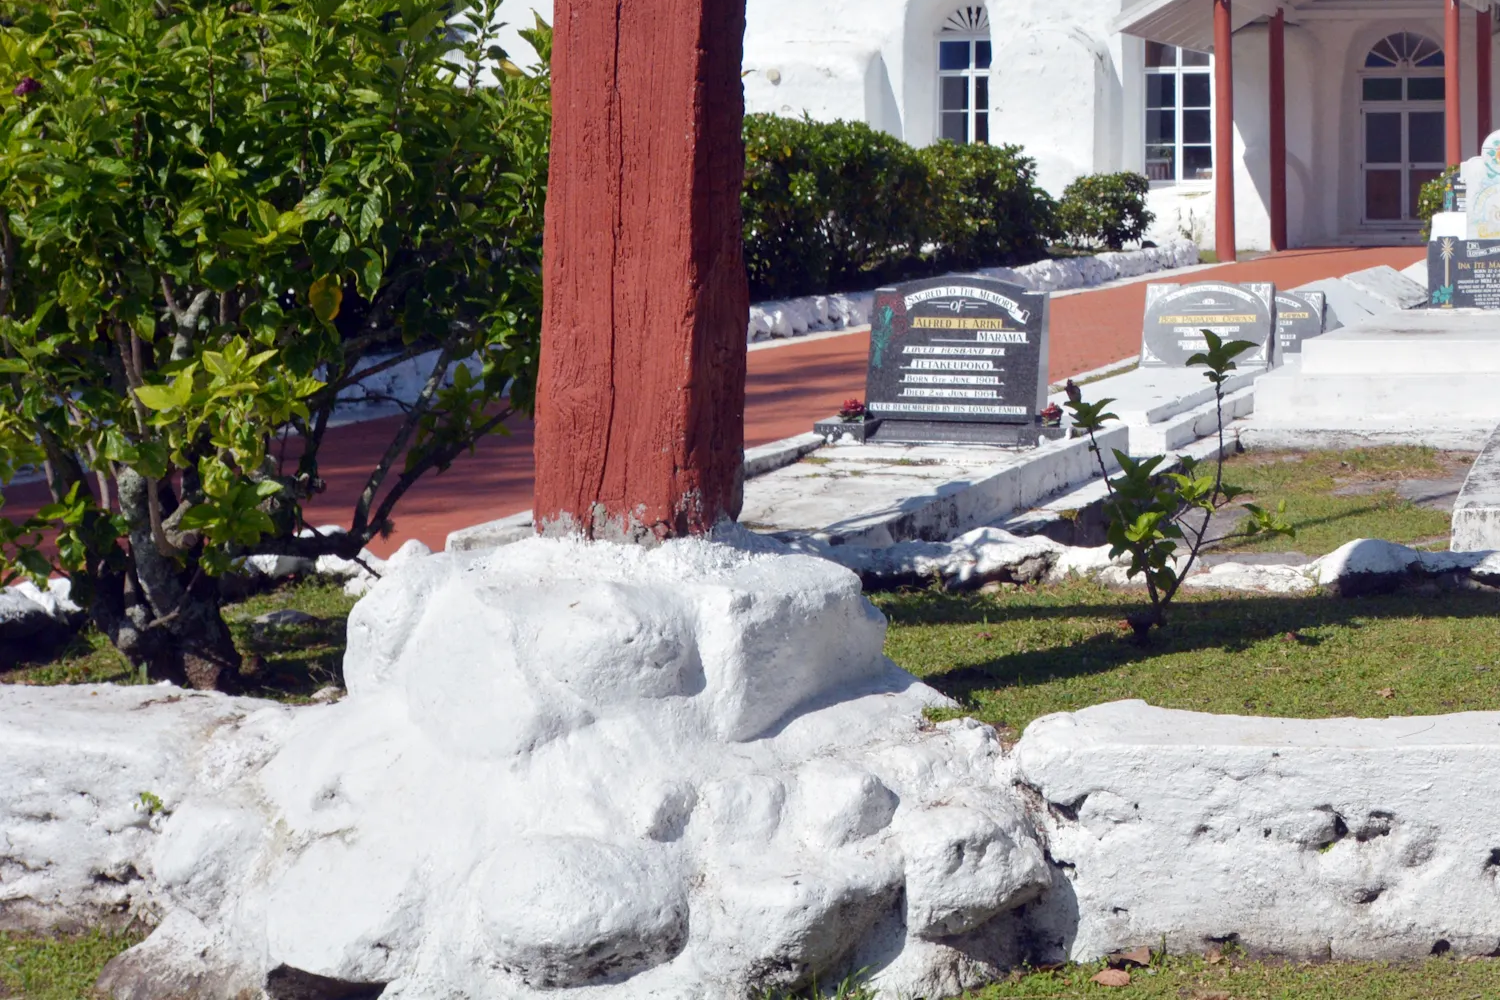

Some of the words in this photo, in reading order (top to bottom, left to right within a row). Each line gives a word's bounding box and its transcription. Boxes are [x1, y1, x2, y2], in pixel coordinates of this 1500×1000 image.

[907, 289, 942, 304] SACRED
[946, 287, 956, 295] TO
[960, 287, 974, 296] THE
[979, 289, 1017, 313] MEMORY
[916, 318, 952, 328] ALFRED
[957, 319, 967, 328] TE
[972, 319, 1002, 329] ARIKI
[979, 332, 1024, 342] MARAMA
